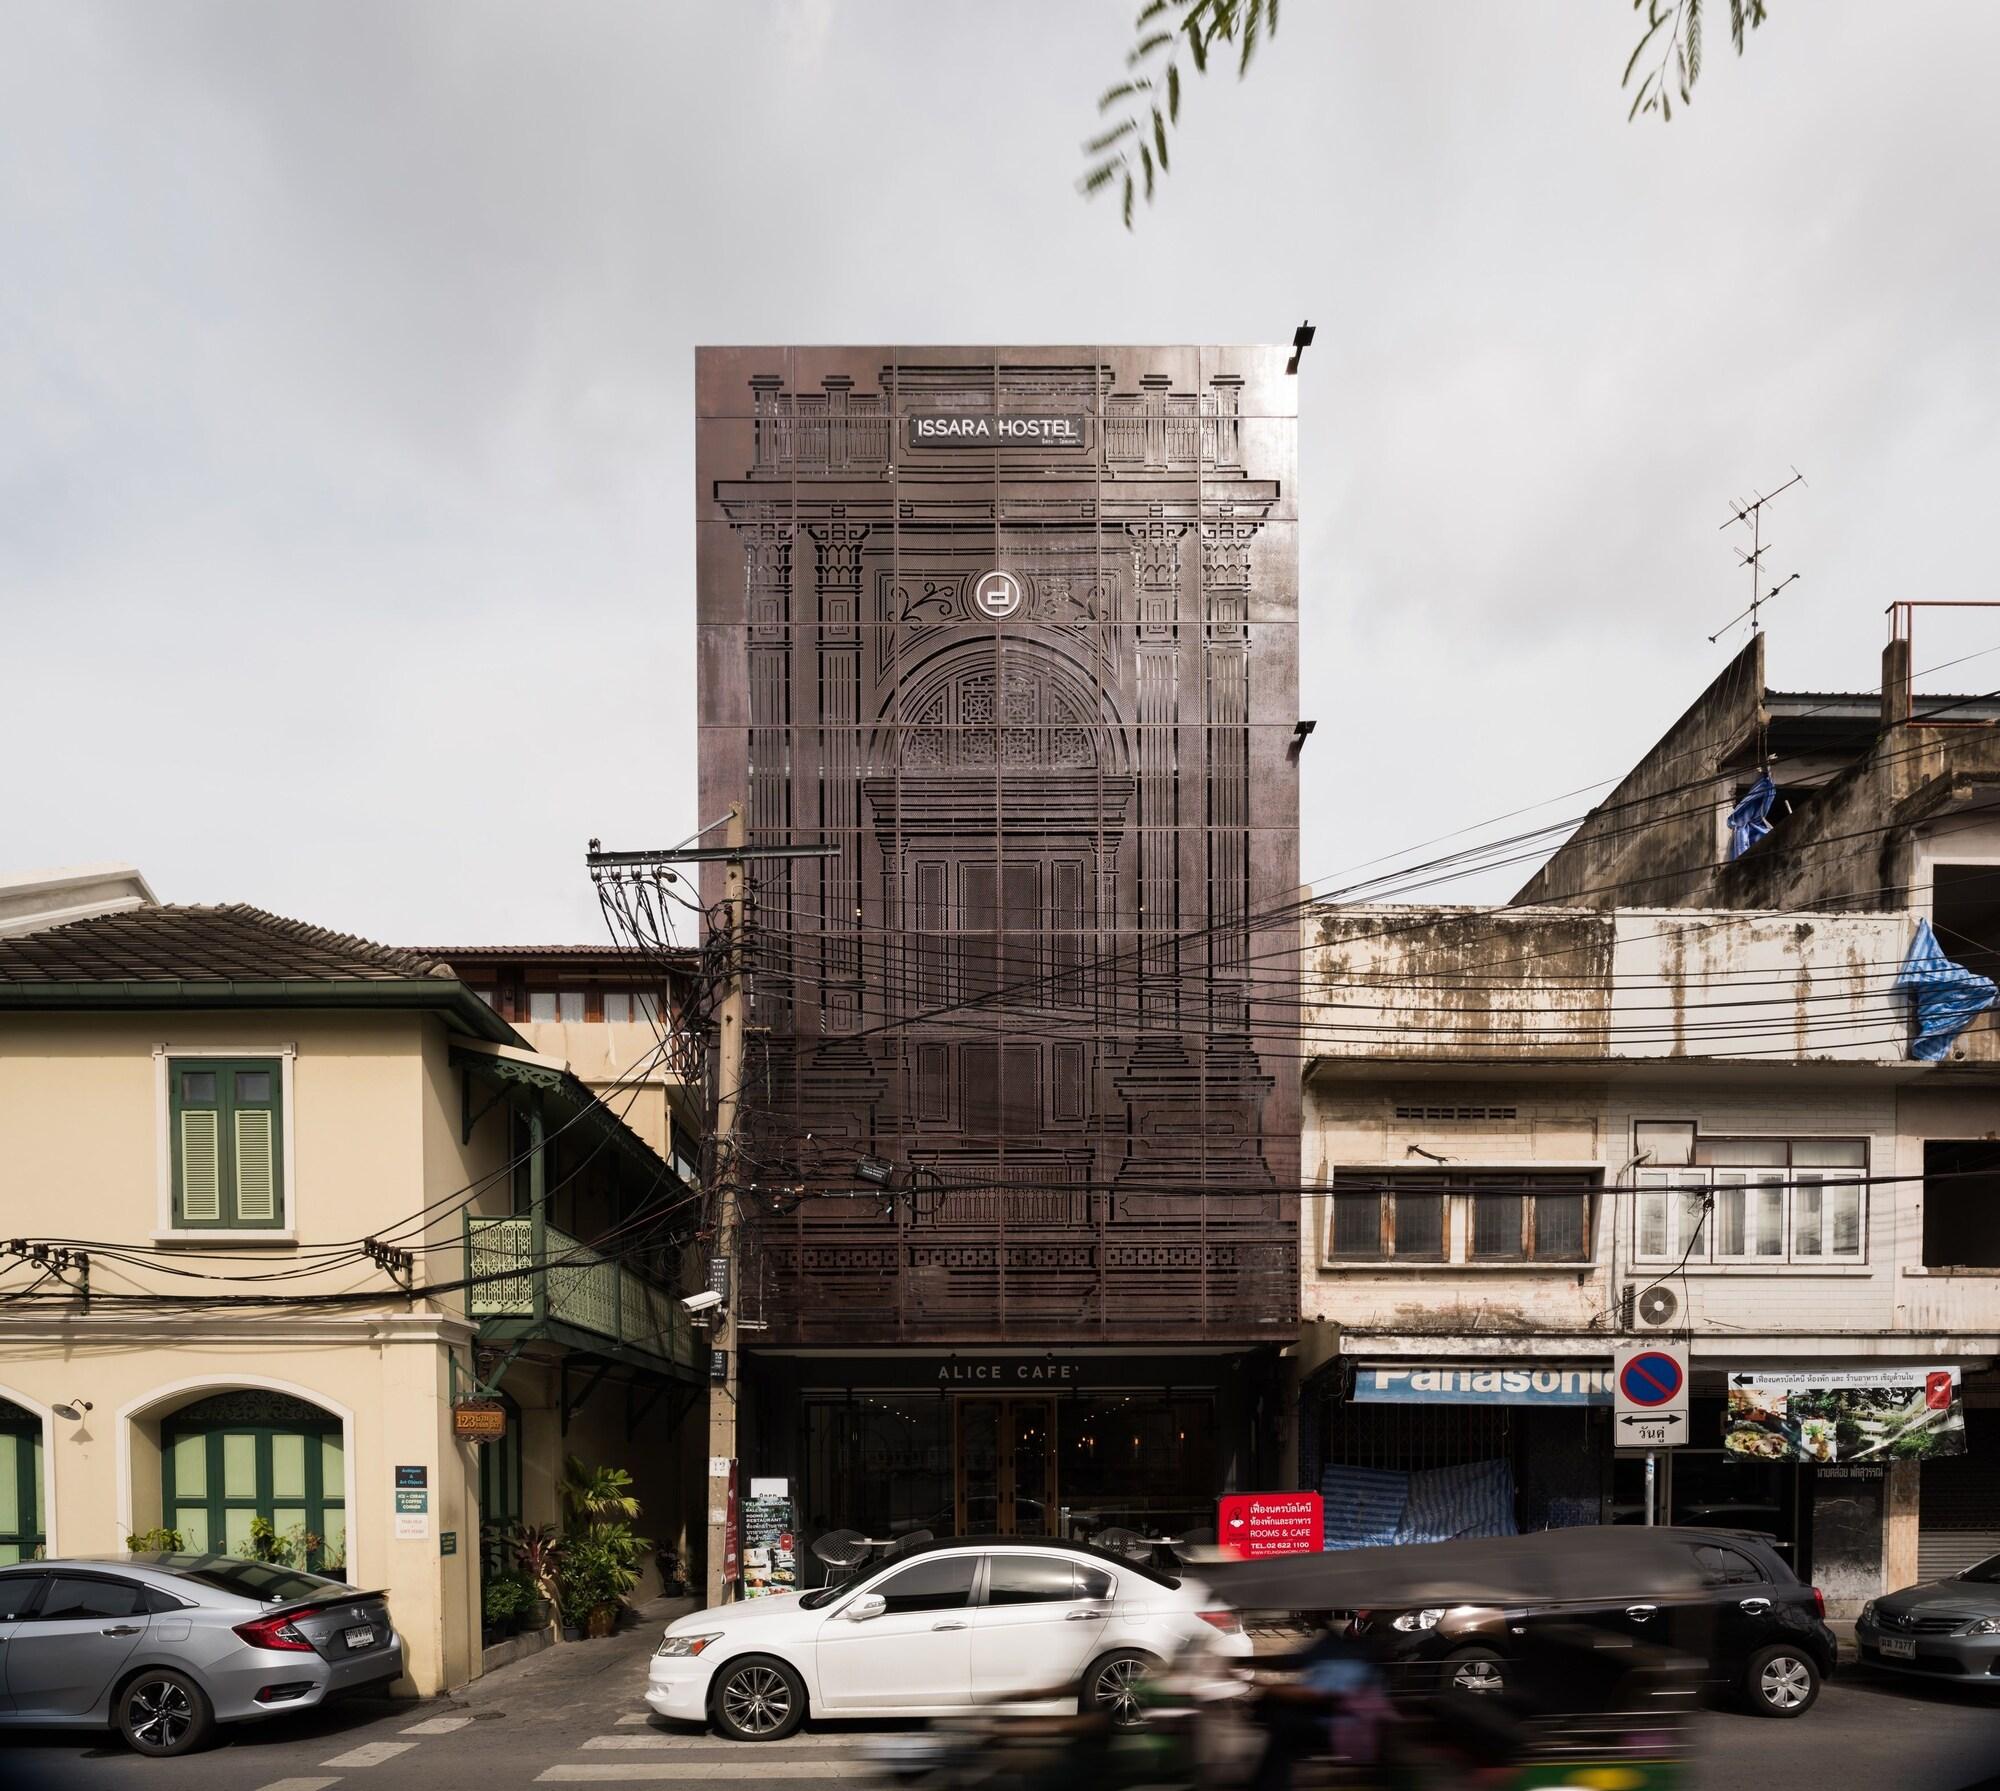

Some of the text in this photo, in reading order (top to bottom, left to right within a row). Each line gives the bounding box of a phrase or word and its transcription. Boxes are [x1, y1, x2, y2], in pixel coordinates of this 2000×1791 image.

[918, 419, 1077, 437] ISSARA HOSTEL
[938, 1365, 1001, 1379] ALICE
[456, 1415, 476, 1428] 123
[1639, 1425, 1665, 1443] วันคู่
[1250, 1516, 1311, 1526] ห้องพักและอาหาร
[1250, 1528, 1311, 1538] ROOMS & CAFE
